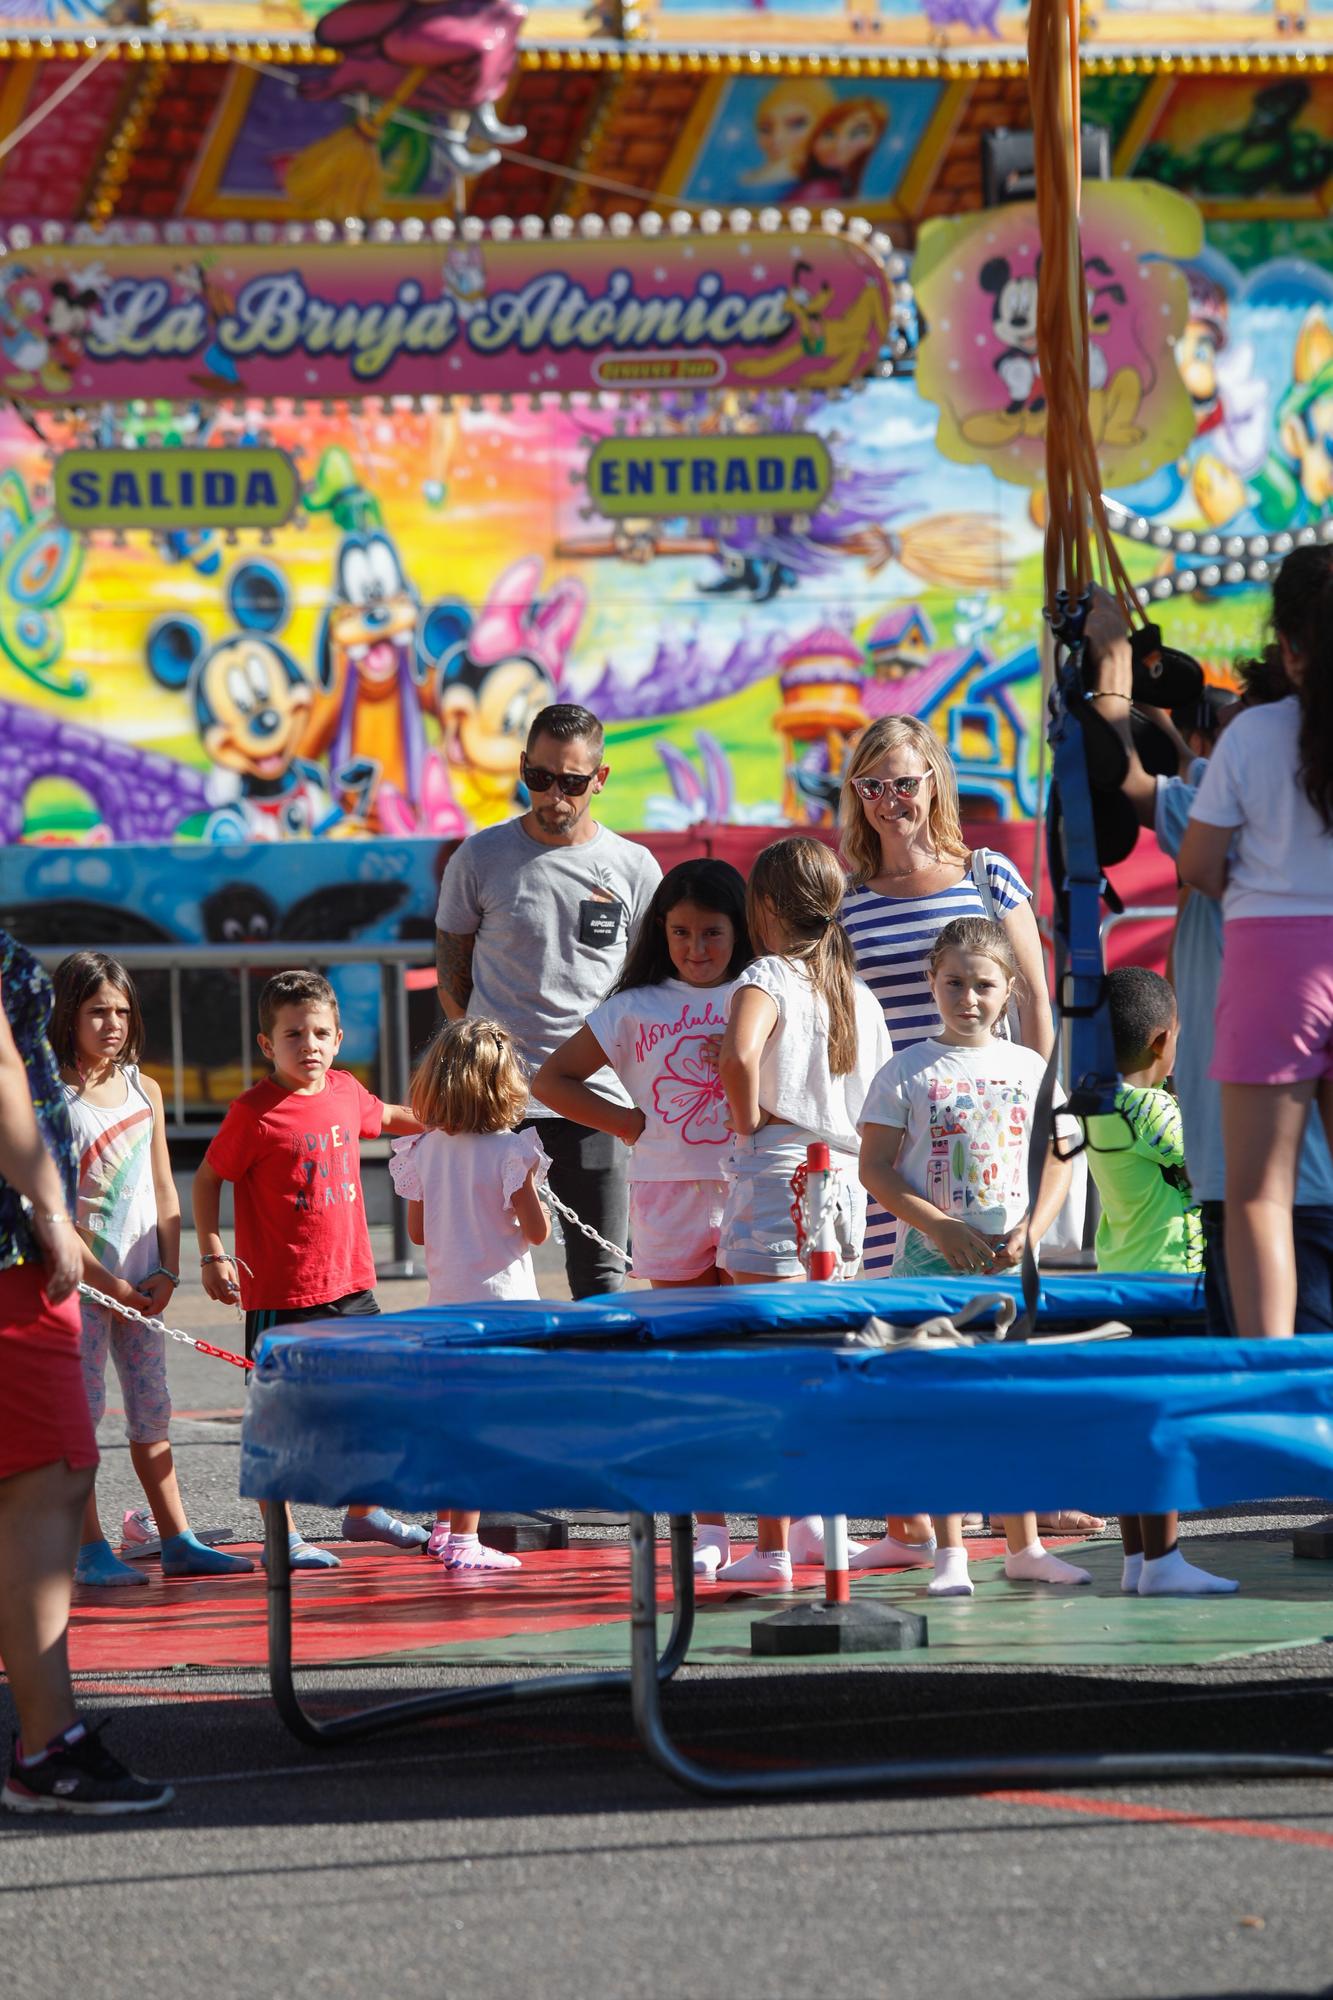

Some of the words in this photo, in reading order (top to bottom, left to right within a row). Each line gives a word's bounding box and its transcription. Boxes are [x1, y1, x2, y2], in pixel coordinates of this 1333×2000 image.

[85, 275, 207, 357] La
[217, 270, 458, 376] Bruja
[68, 470, 279, 508] SALIDA
[600, 456, 819, 495] ENTRADA
